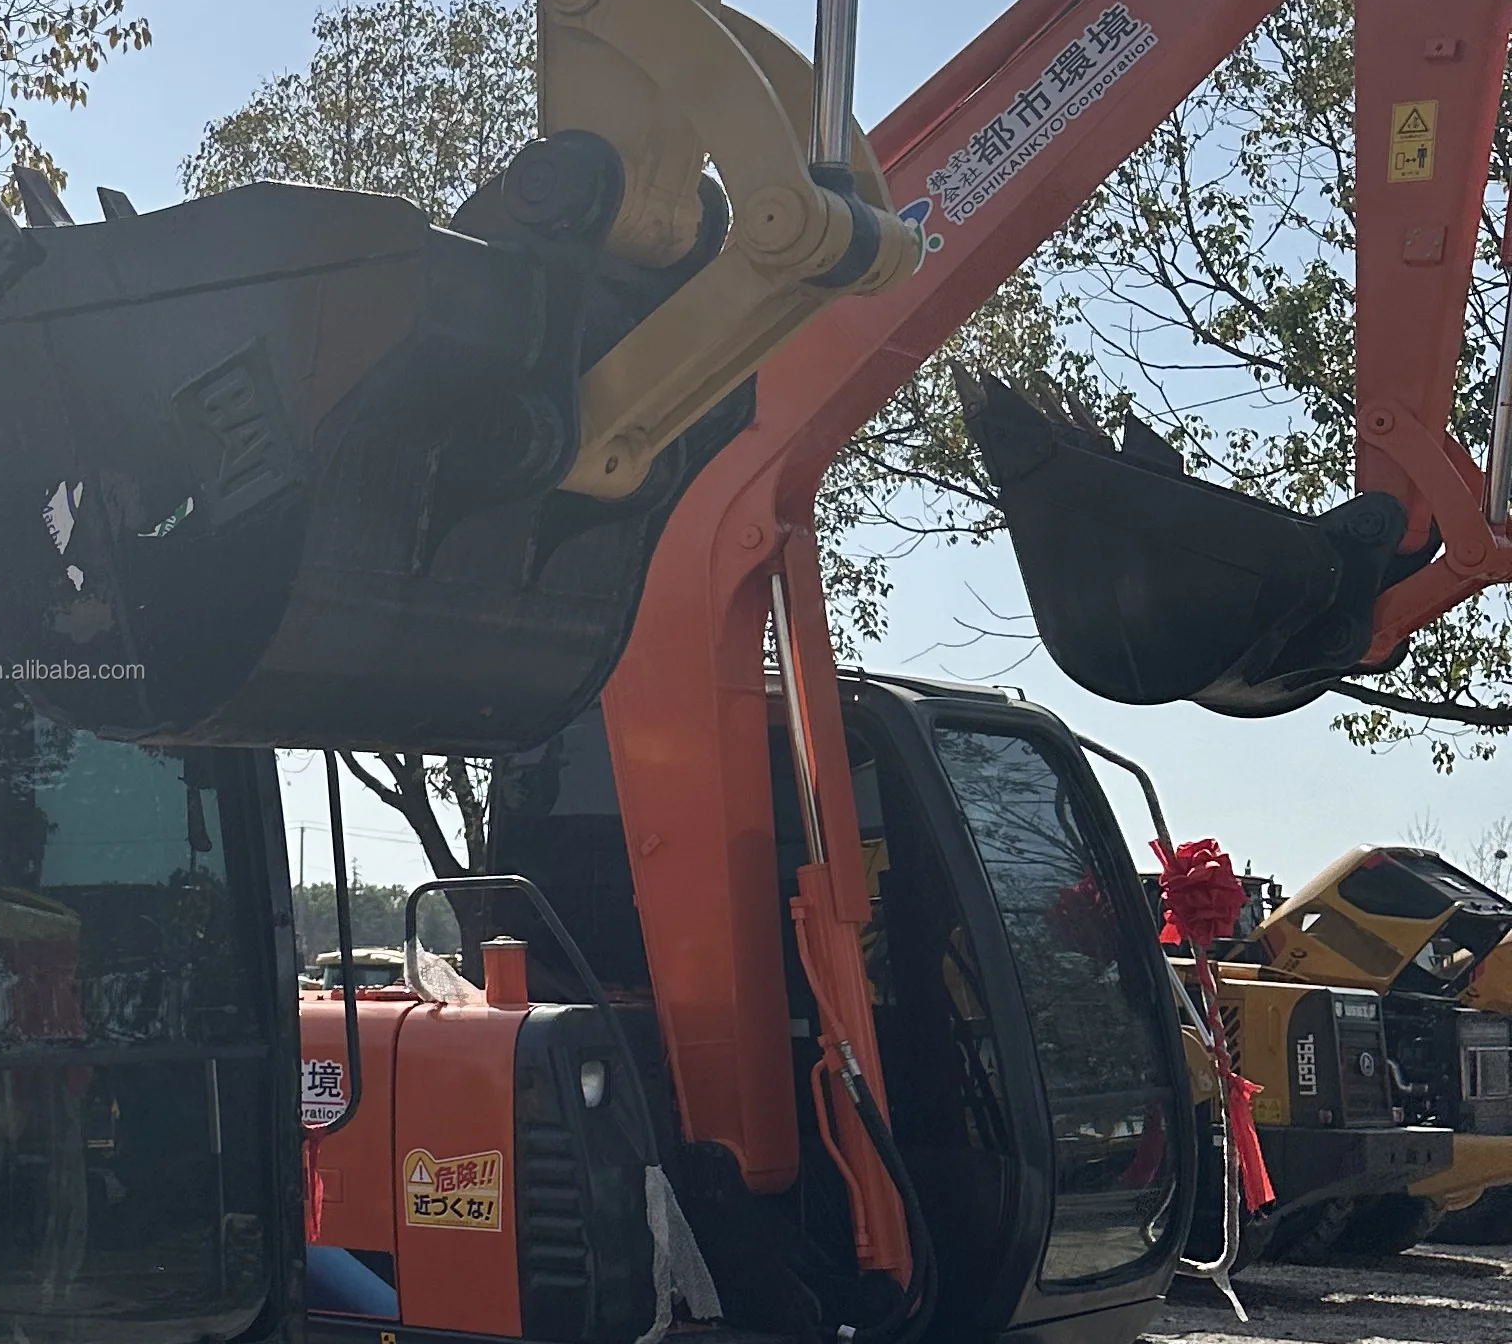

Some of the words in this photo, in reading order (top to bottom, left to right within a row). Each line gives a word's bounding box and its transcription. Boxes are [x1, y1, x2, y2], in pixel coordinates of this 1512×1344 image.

[970, 5, 1138, 164] 都市環境
[950, 118, 1063, 223] TOSHIKANKYO
[1066, 34, 1155, 117] Corporation
[302, 1062, 341, 1098] 境
[1297, 1034, 1317, 1096] LG956L
[413, 1194, 494, 1221] 近づくな!
